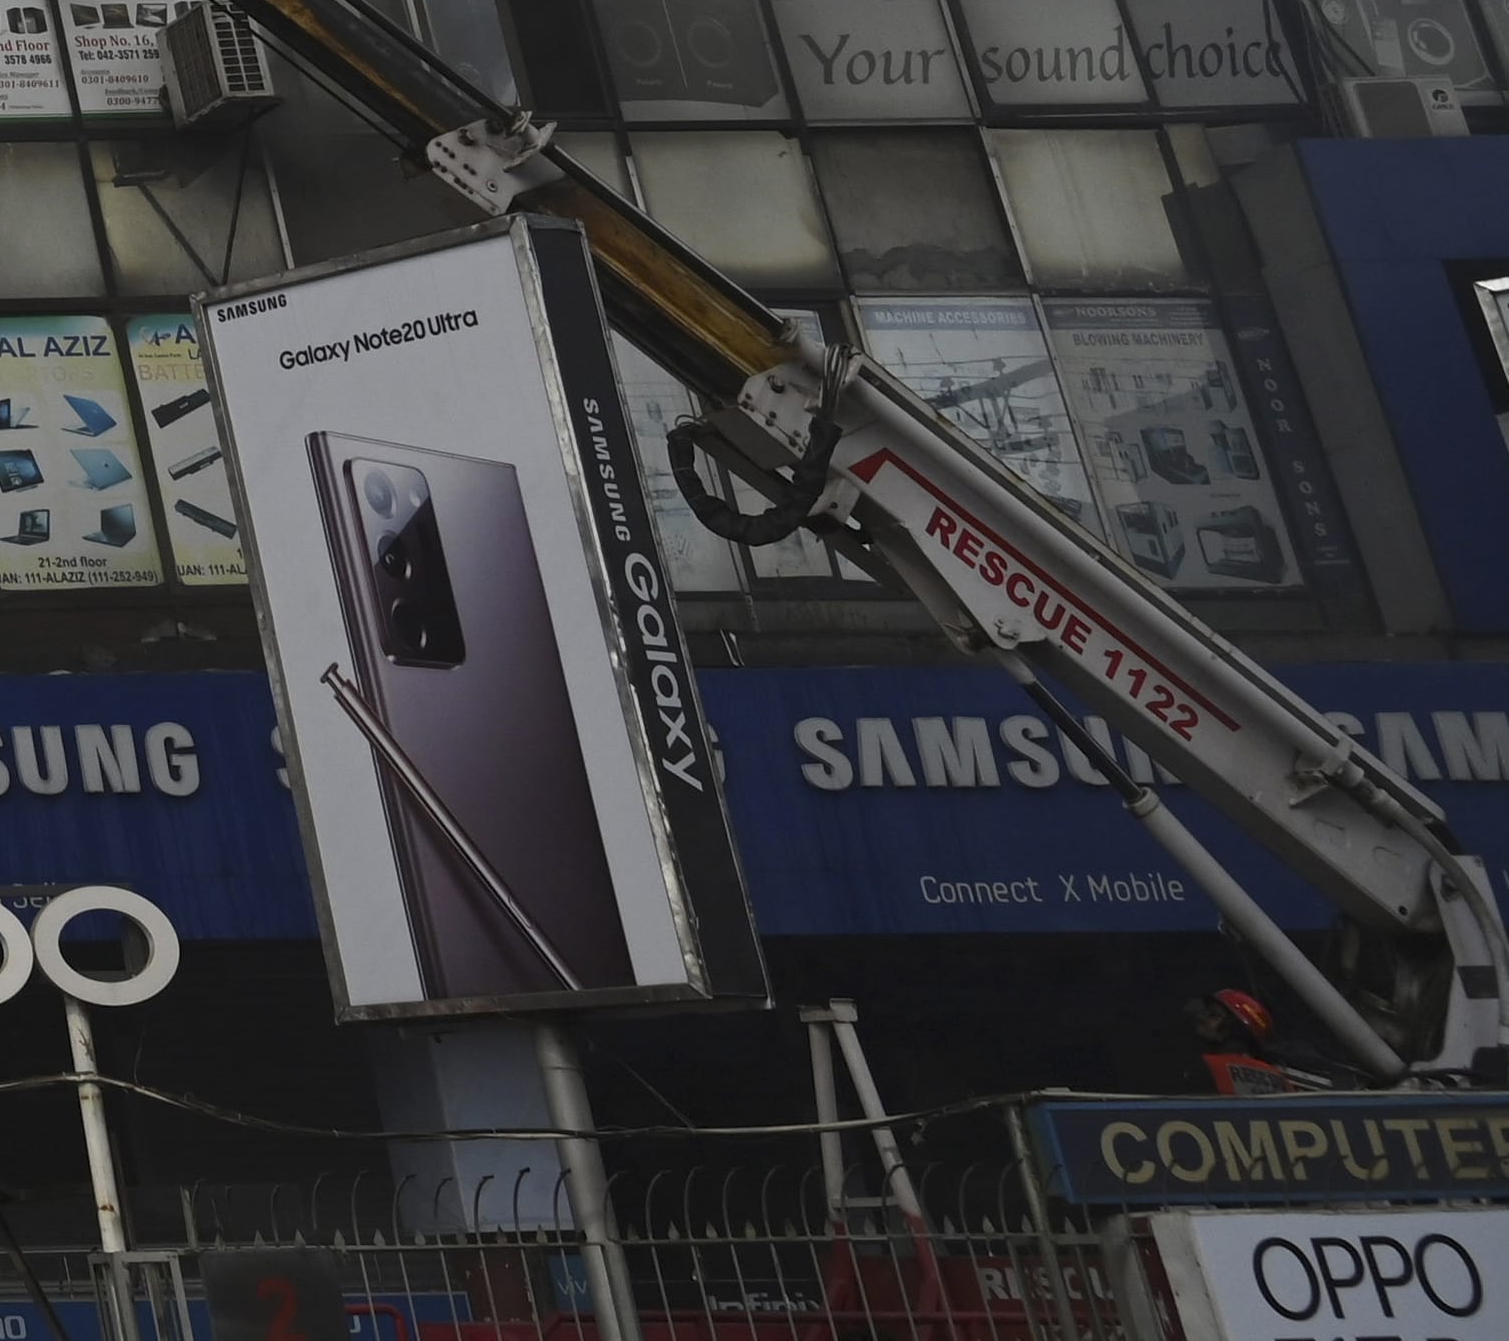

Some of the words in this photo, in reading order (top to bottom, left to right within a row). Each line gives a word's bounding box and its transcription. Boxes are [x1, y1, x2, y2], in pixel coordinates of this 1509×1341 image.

[16, 39, 51, 52] Floor
[74, 35, 107, 48] Shop
[109, 35, 131, 47] No.
[135, 35, 154, 48] 16,
[799, 32, 948, 87] Your
[981, 26, 1131, 84] sound
[1142, 22, 1285, 81] choice
[79, 50, 96, 61] Tel:
[97, 50, 140, 61] 042-3571
[217, 293, 289, 323] SAMSUNG
[874, 310, 935, 326] MACHINE
[937, 310, 1026, 326] ACCESSORIES
[43, 335, 111, 358] AZIZ
[279, 333, 353, 370] Galaxy
[353, 320, 427, 354] Note20
[429, 307, 479, 337] Ultra
[1072, 332, 1130, 348] BLOWING
[1131, 331, 1205, 347] MACHINERY
[37, 556, 78, 568] 21-2nd
[80, 556, 108, 568] floor
[24, 571, 86, 584] 111-ALAZIZ
[88, 570, 159, 585] (111-252-949)
[581, 397, 632, 543] SAMSUNG
[623, 550, 705, 793] Galaxy
[924, 506, 1093, 656] RESCUE
[1103, 648, 1201, 743] 1122
[794, 714, 1185, 791] SAMSU
[920, 874, 1040, 905] Connect
[1062, 874, 1082, 904] X
[1088, 872, 1185, 904] Mobile
[1253, 1233, 1483, 1320] OPPO
